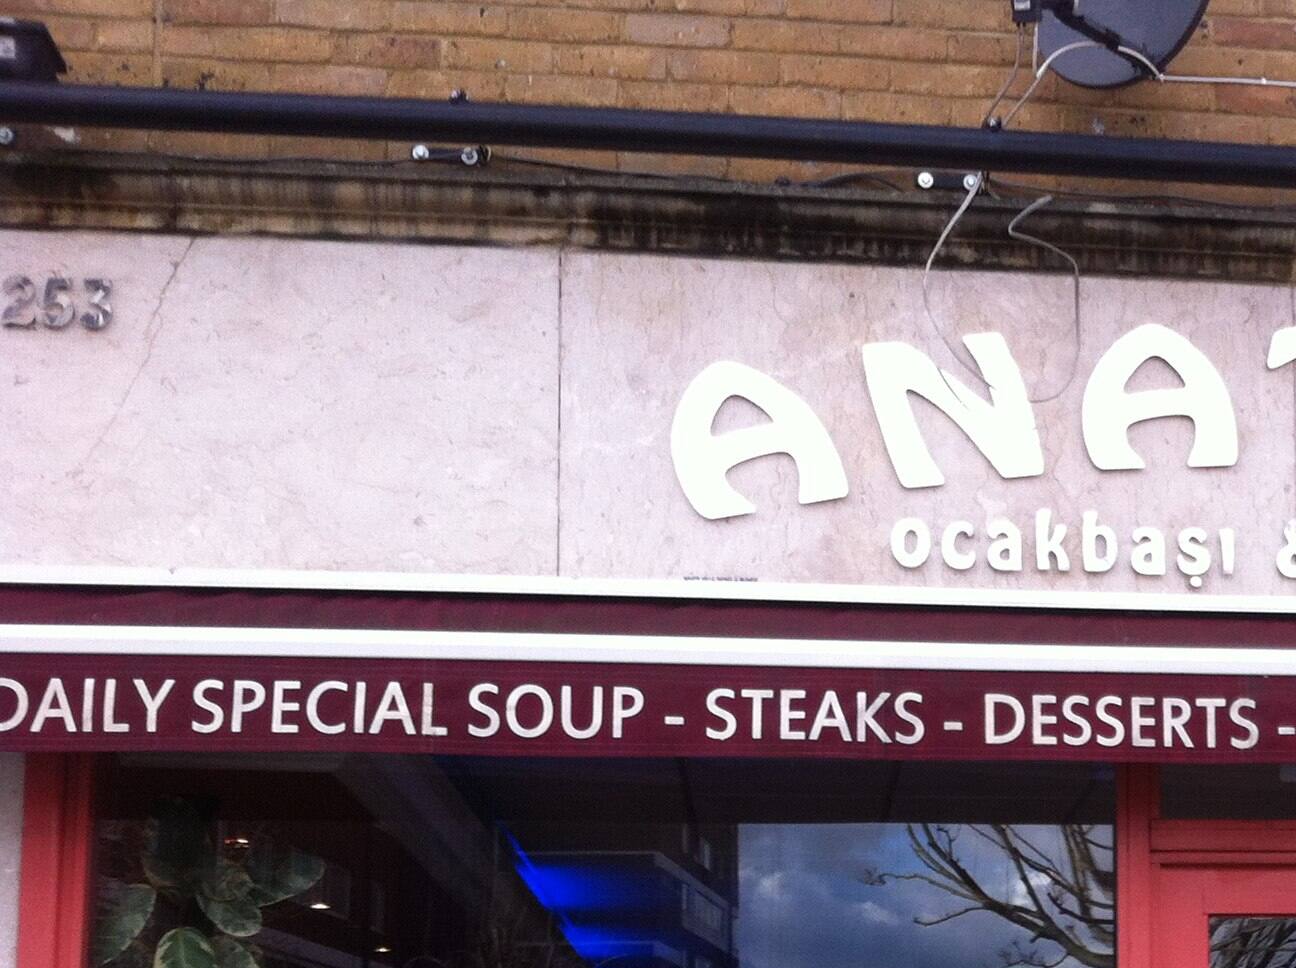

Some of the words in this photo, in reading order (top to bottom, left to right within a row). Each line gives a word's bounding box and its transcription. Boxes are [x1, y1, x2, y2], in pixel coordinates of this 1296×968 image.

[2, 276, 113, 331] 253
[0, 677, 175, 733] DAILY
[192, 679, 447, 736] SPECIAL
[468, 683, 644, 740] SOUP
[706, 688, 924, 745] STEAKS
[984, 693, 1259, 750] DESSERTS
